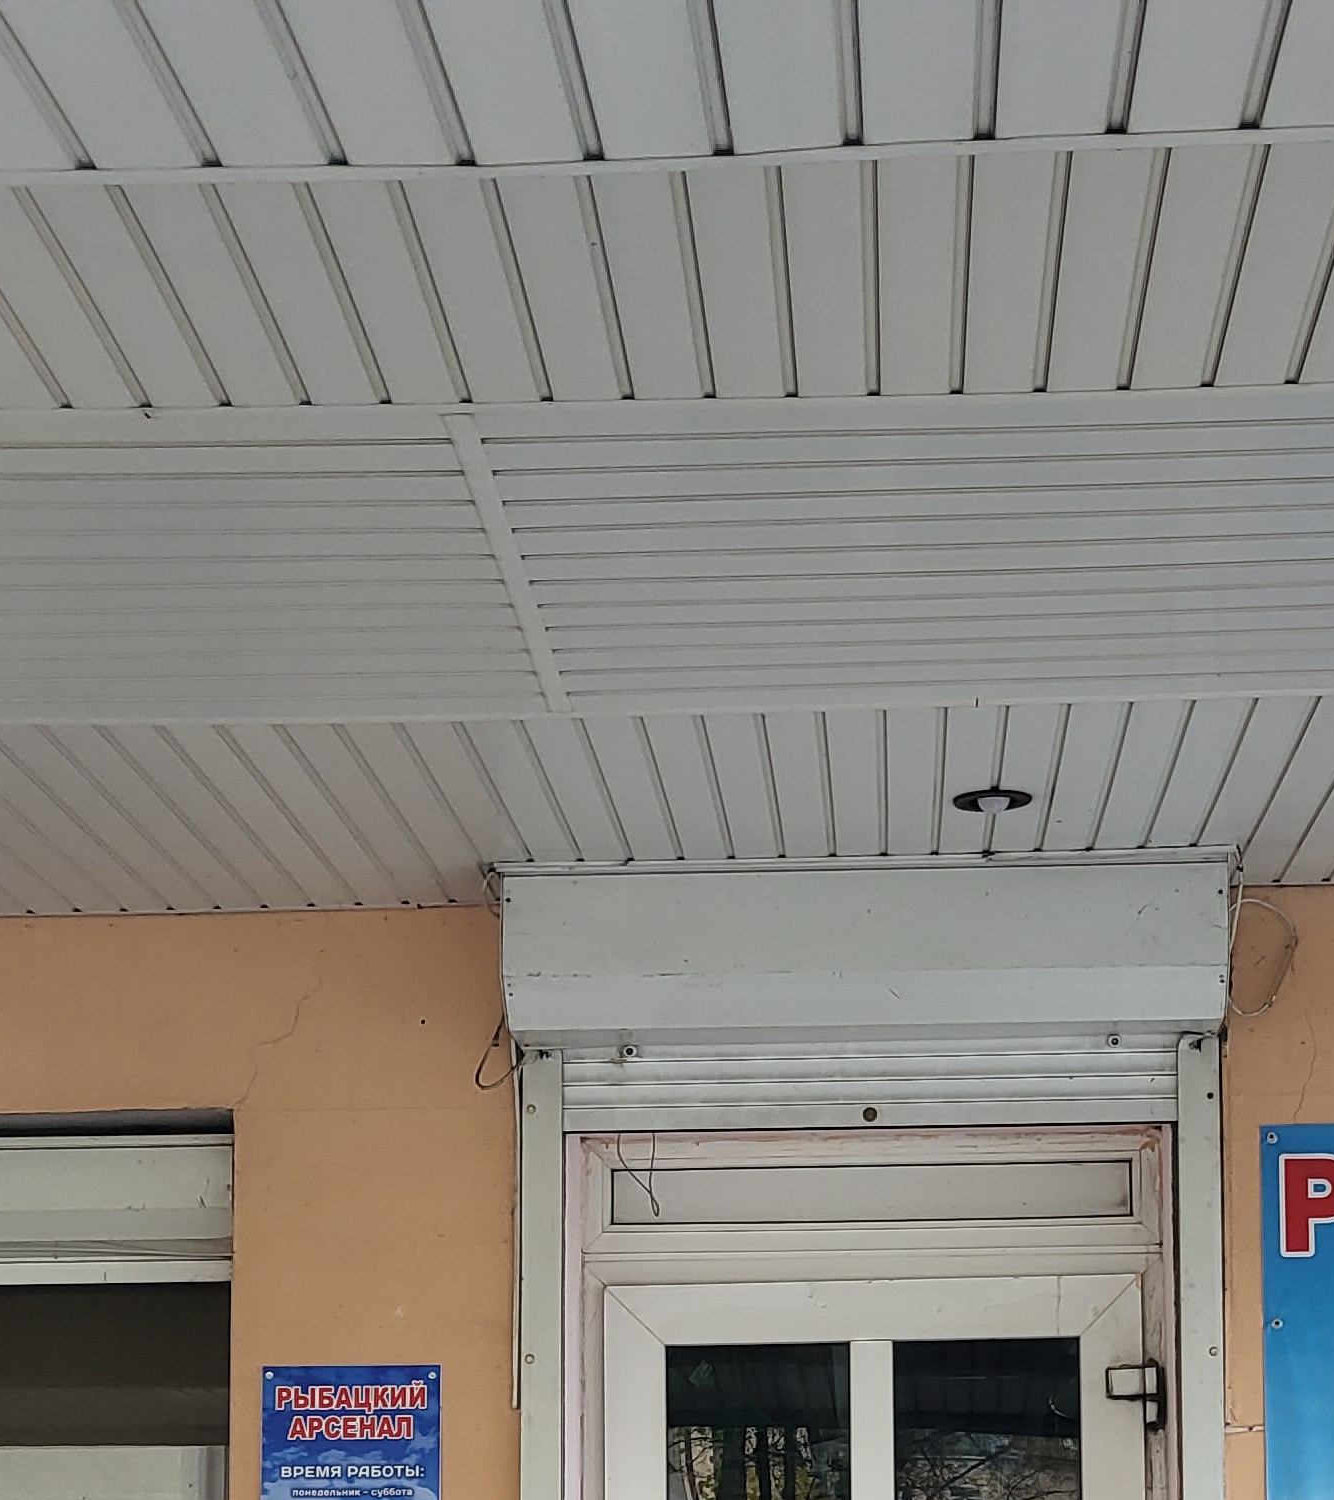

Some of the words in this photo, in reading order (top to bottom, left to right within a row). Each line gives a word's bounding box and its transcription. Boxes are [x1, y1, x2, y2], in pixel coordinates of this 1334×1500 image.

[276, 1380, 427, 1413] РЫБАЦКИЙ
[287, 1414, 414, 1440] АРСЕНАЛ
[280, 1465, 342, 1478] ВРЕМЯ
[347, 1465, 425, 1478] РАБОТЫ:
[292, 1488, 361, 1497] понедельник
[370, 1488, 413, 1498] суббота
